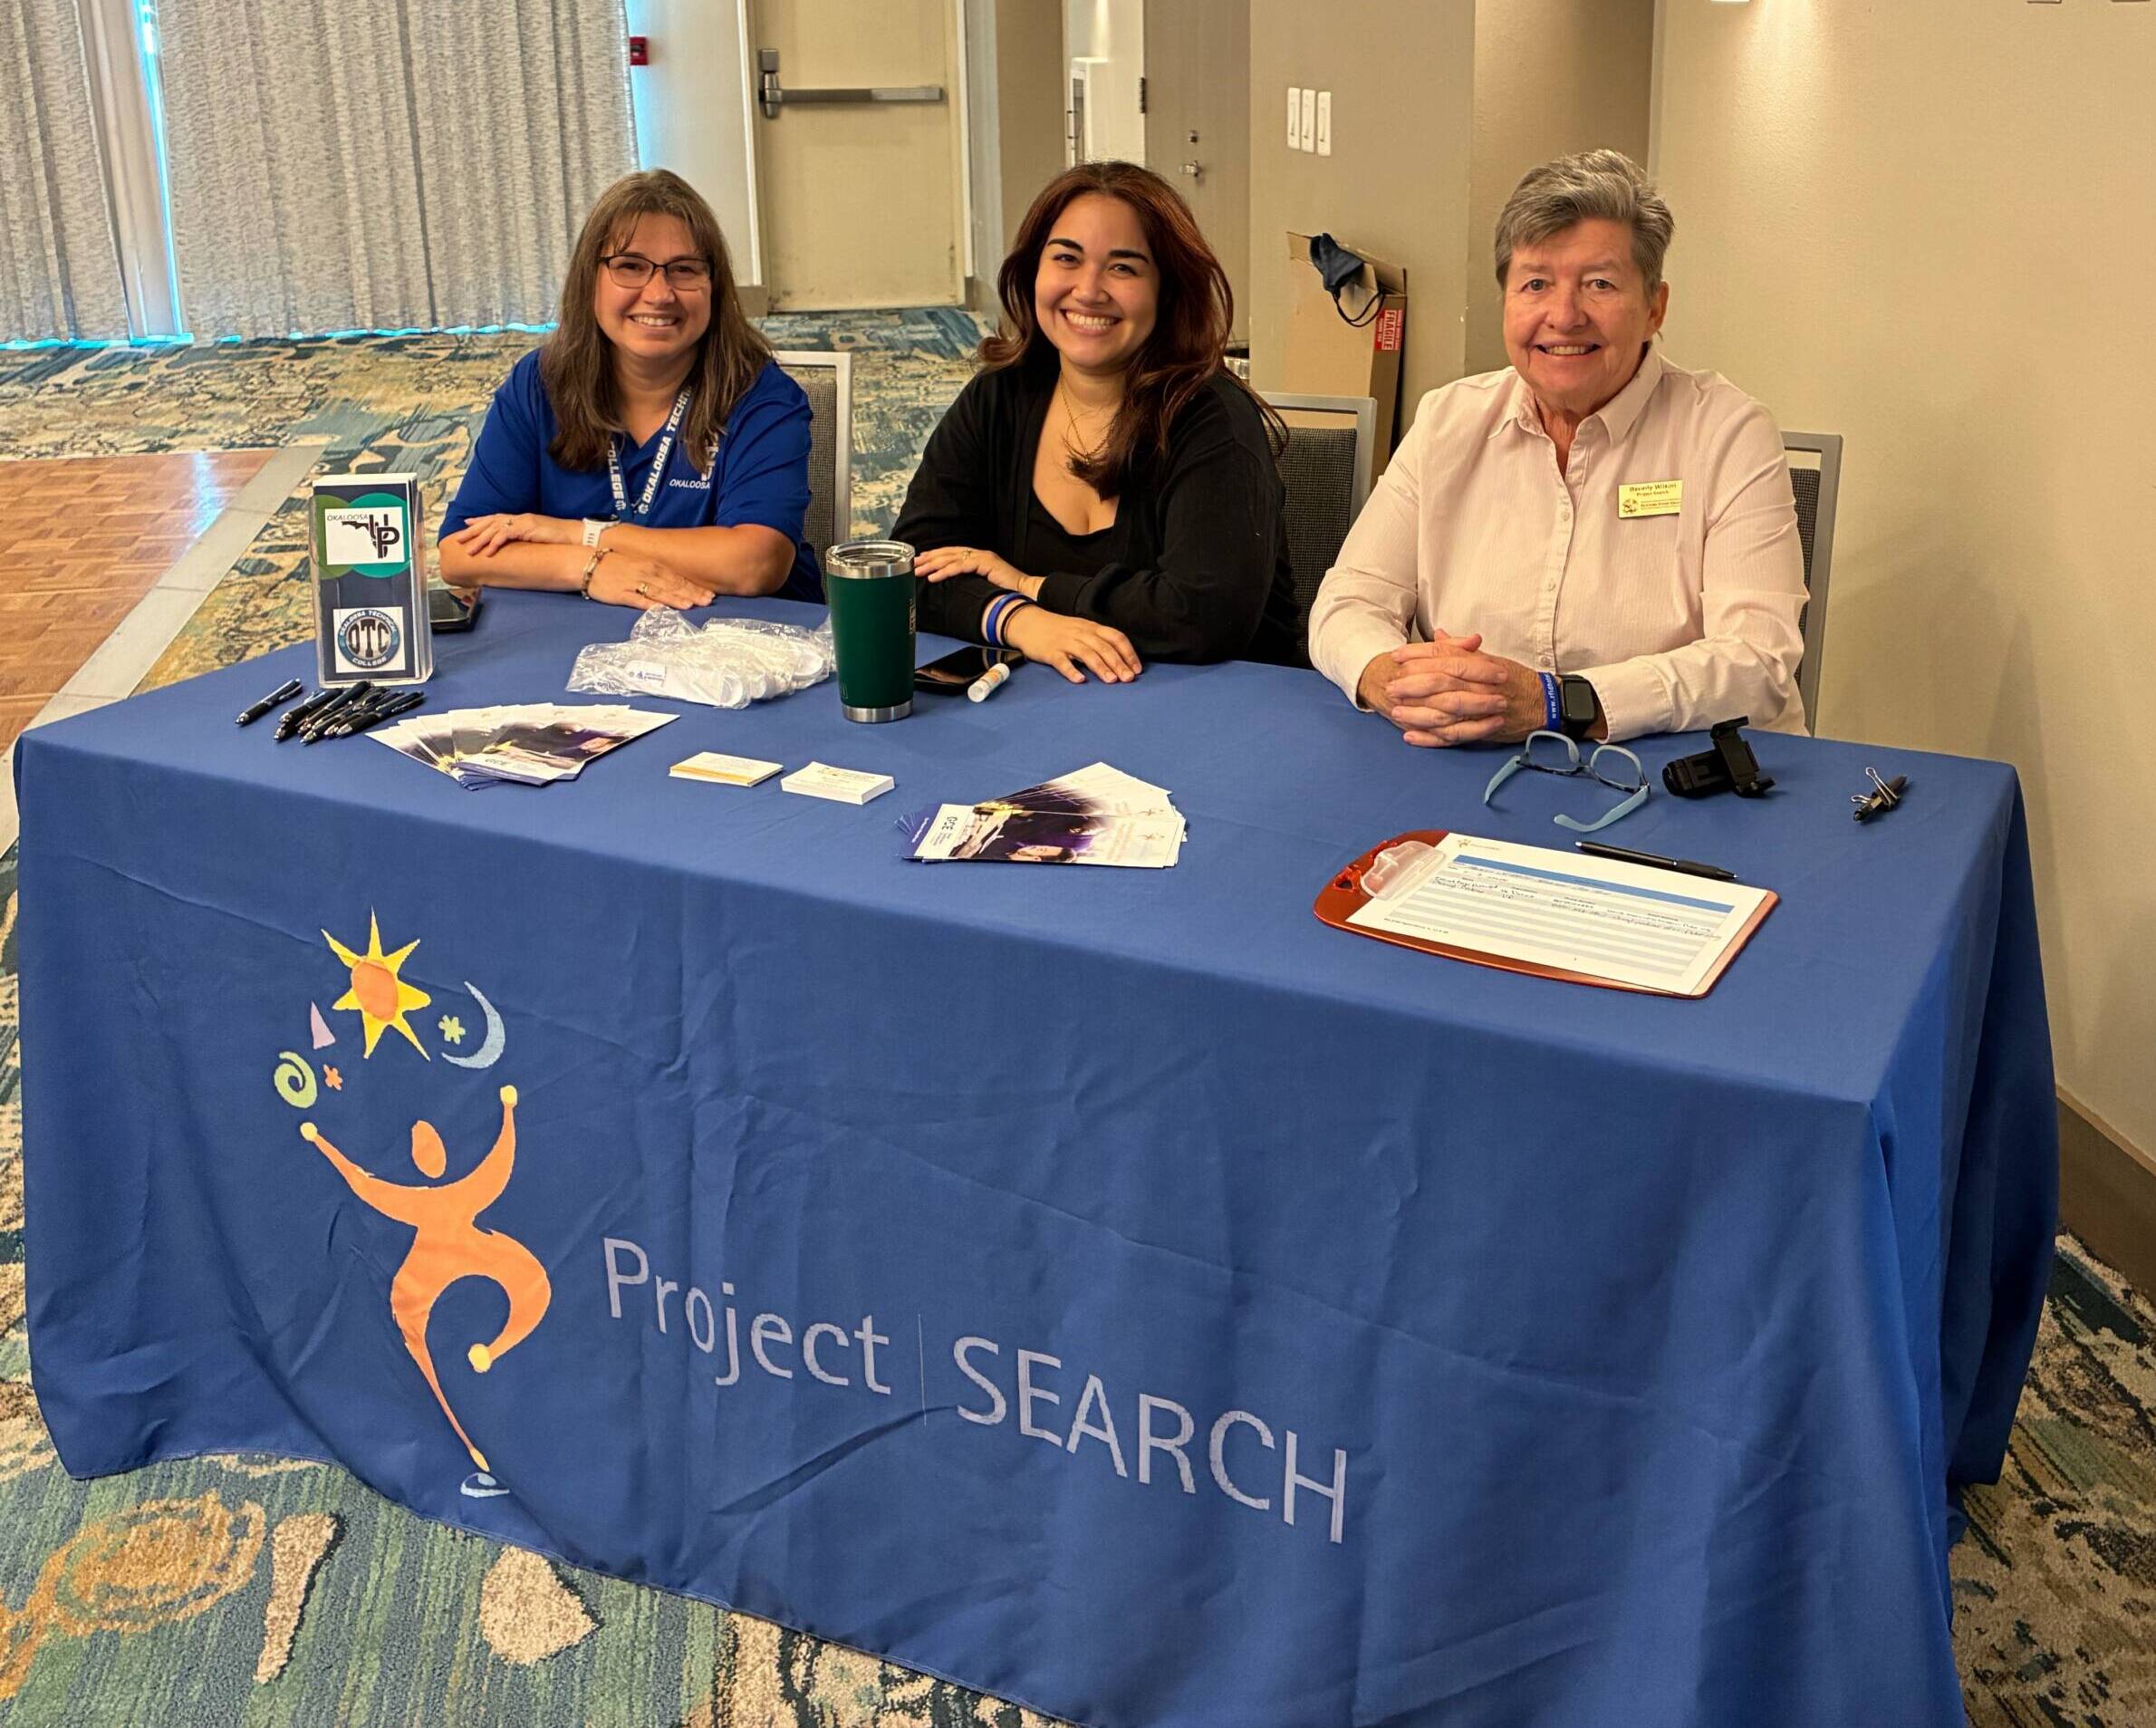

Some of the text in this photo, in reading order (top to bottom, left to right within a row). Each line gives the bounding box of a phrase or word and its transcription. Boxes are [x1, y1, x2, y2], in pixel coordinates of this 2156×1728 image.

[1383, 311, 1396, 349] FRAGILE
[642, 436, 672, 504] OKALOOSA
[669, 478, 710, 489] OKALOOSA
[348, 619, 389, 658] OTC
[604, 1238, 1346, 1543] Project SEARCH
